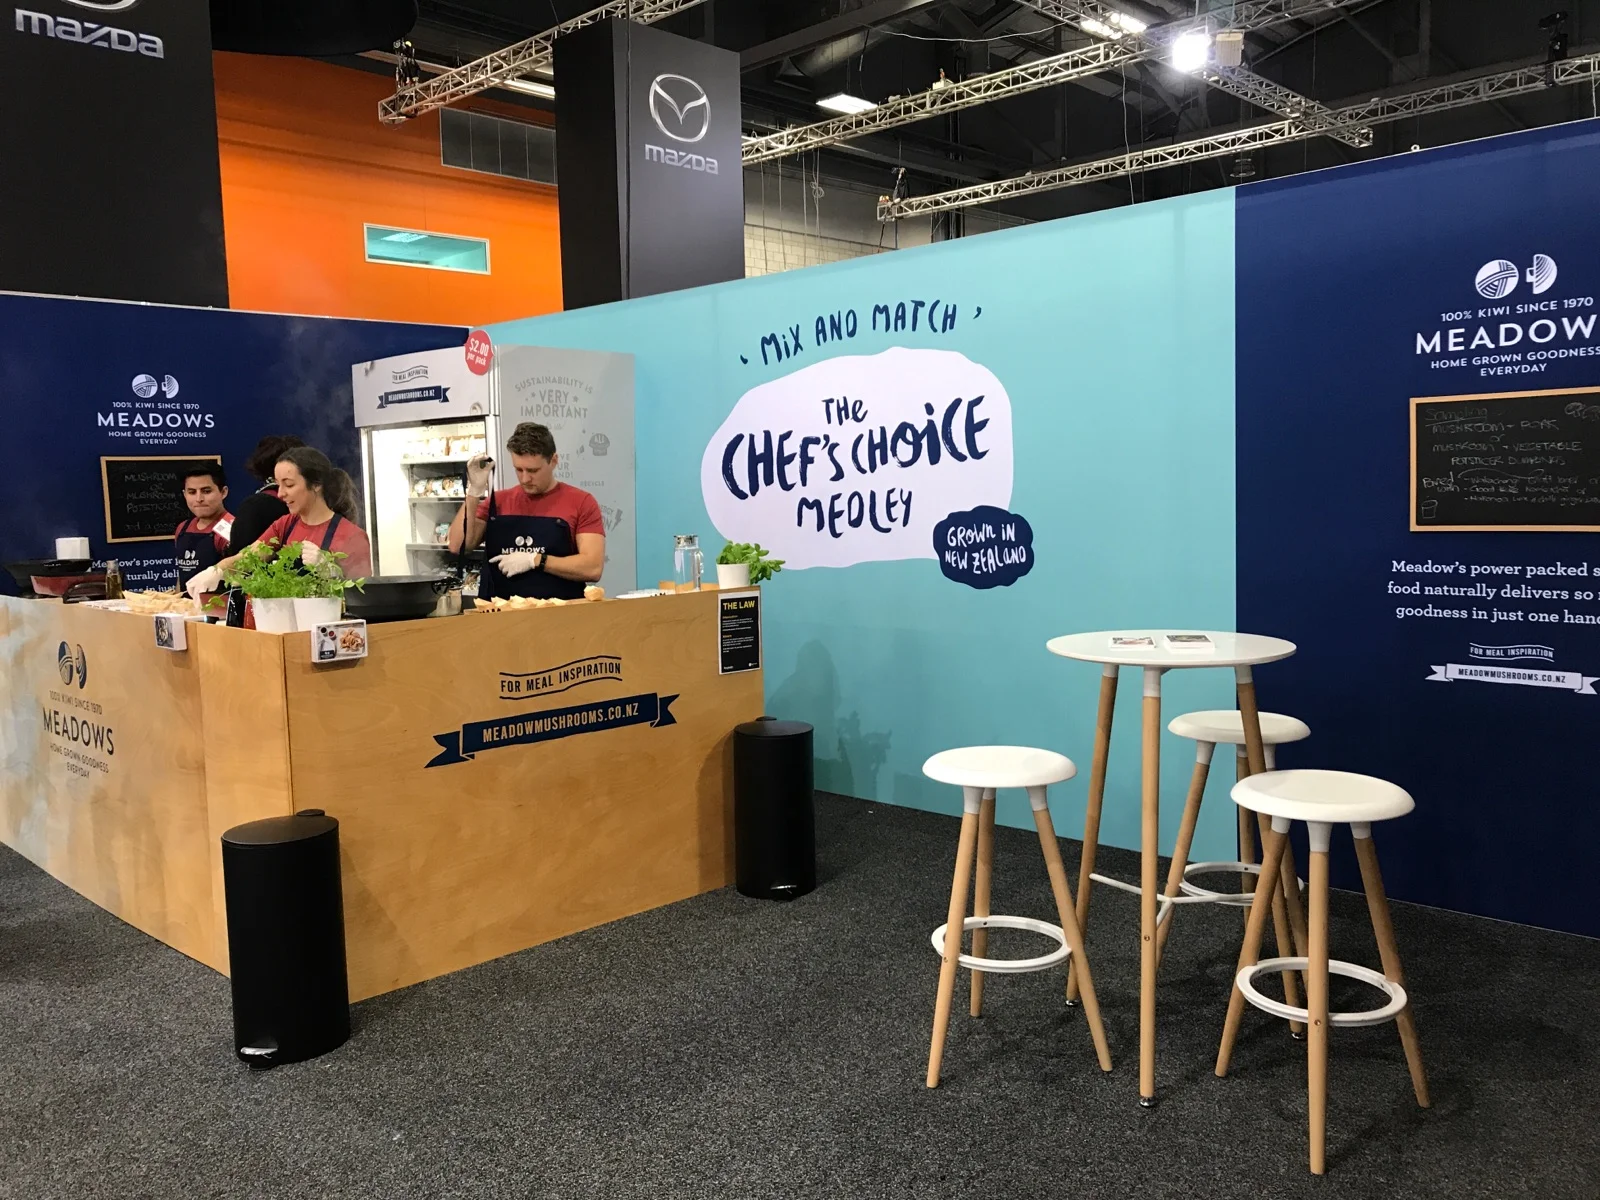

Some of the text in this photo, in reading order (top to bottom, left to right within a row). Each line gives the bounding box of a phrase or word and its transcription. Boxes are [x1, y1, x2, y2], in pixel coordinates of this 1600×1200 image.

[1441, 296, 1594, 322] 100% KIWI SINCE 1970
[815, 309, 858, 346] AND
[872, 300, 957, 333] MATCH
[1416, 314, 1598, 354] MEADOW
[469, 338, 490, 356] $2.00
[1431, 346, 1600, 369] HOME GROWN GOODNESS
[1480, 363, 1547, 376] EVERYDAY
[515, 376, 583, 392] SUSTAINABILITY
[539, 389, 569, 404] VERY
[97, 412, 215, 428] MEADOWS
[520, 404, 588, 418] IMPORTANT
[797, 488, 913, 539] MEDLEY
[143, 557, 173, 567] power
[945, 549, 968, 570] NEW
[1391, 560, 1466, 574] Meadow's
[1470, 565, 1522, 577] power
[1525, 562, 1588, 578] packed
[1388, 581, 1420, 595] food
[1424, 583, 1497, 600] naturally
[1500, 584, 1569, 600] delivers
[1574, 590, 1594, 601] so
[723, 600, 755, 610] THE LAW
[1396, 604, 1468, 619] goodness
[1472, 608, 1488, 620] in
[1490, 608, 1523, 623] just
[1528, 611, 1559, 623] one
[1470, 646, 1554, 658] FOR MEAL INSPIRATION
[500, 662, 621, 692] FOR MEAL INSPIRATION
[1458, 668, 1566, 684] MEADOWMUSHROOMS.CO.NZ
[75, 697, 89, 711] SINCE
[91, 702, 102, 715] 1970
[43, 707, 114, 756] MEADOWS
[482, 702, 639, 743] MEADOWMUSHROOMS.CO.NZ
[50, 743, 109, 773] HOME GROWN GOODNESS
[67, 762, 90, 779] EVERYDAY
